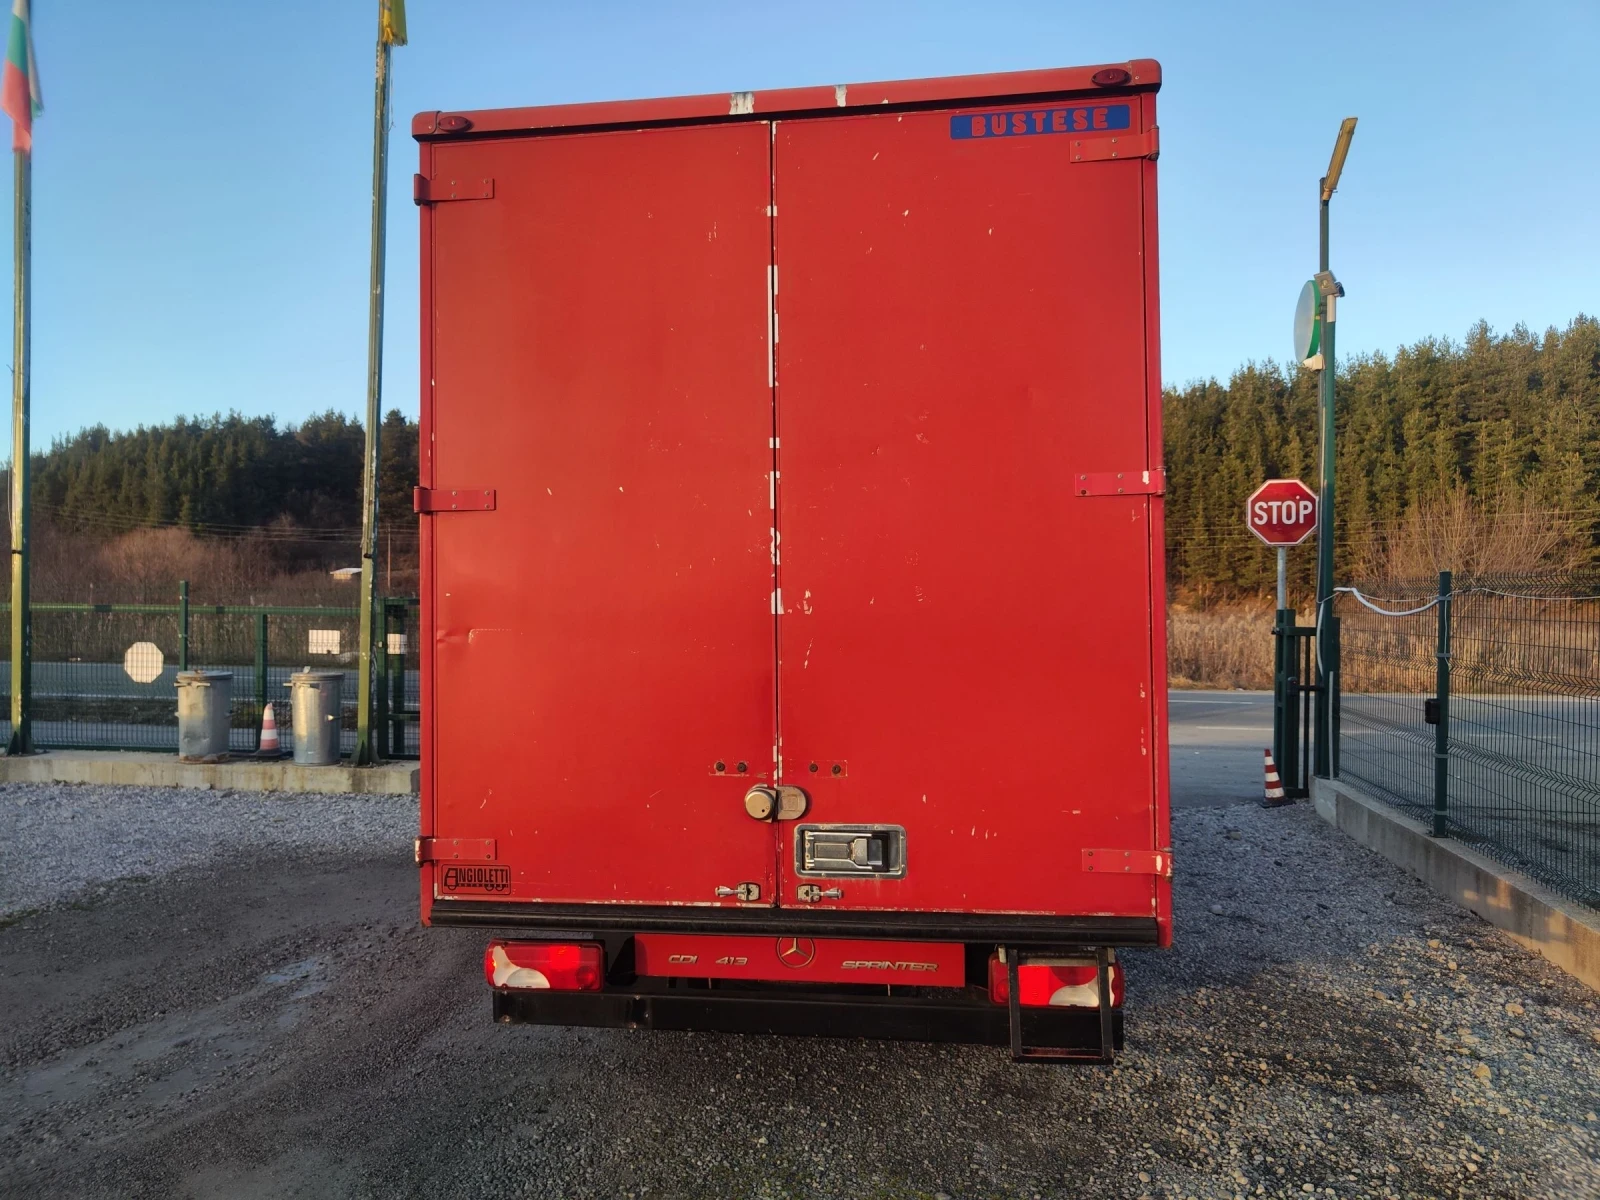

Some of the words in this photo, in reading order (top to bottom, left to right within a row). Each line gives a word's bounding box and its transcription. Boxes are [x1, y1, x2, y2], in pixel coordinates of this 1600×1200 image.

[971, 107, 1108, 136] BUSTESE
[1253, 500, 1313, 525] STOP
[668, 954, 698, 964] CDI
[715, 956, 748, 965] 413
[841, 960, 938, 972] SPRINTER
